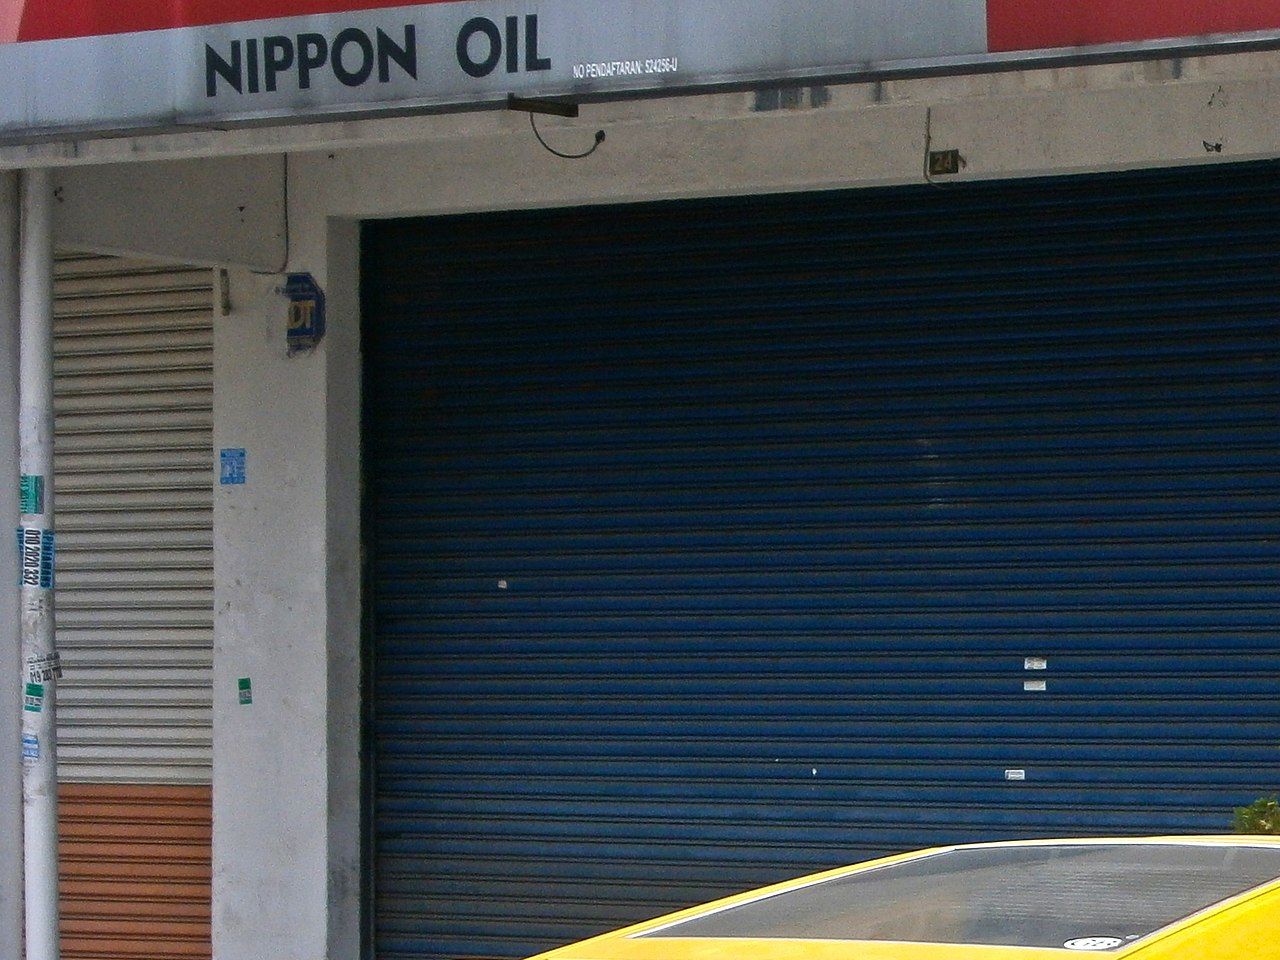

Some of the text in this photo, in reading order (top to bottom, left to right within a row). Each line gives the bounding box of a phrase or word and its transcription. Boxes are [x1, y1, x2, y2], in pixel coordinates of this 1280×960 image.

[205, 14, 551, 97] NIPPON OIL
[573, 64, 585, 78] NO
[25, 530, 41, 544] 010
[25, 546, 40, 567] 2020
[24, 569, 39, 585] 332
